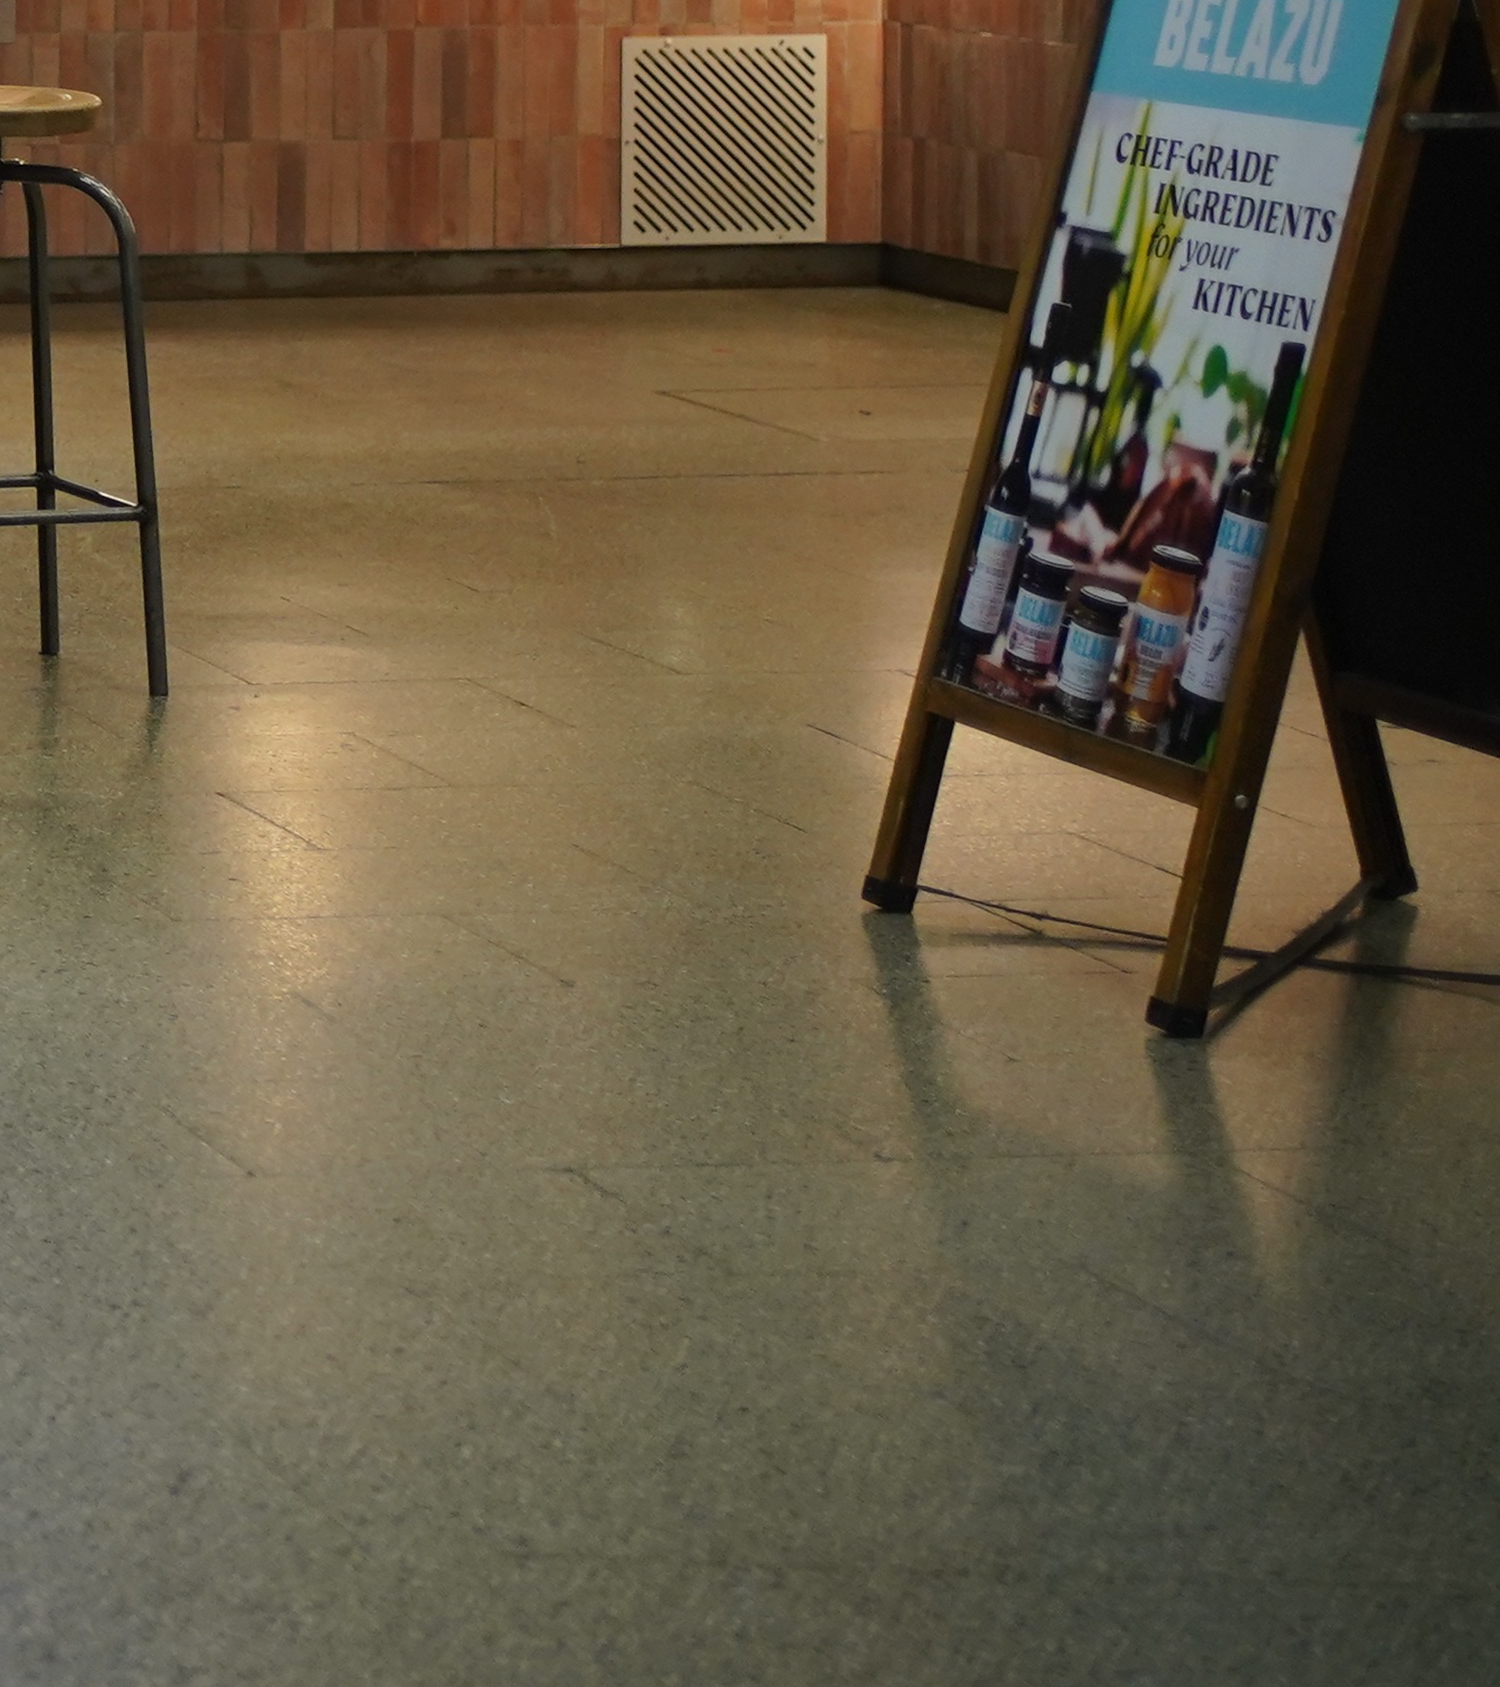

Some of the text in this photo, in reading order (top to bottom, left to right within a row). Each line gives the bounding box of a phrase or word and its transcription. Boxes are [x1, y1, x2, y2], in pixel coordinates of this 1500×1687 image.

[1114, 131, 1281, 188] CHEF-GRADE
[1153, 182, 1338, 244] INGREDIENTS
[1146, 221, 1241, 272] for your
[1191, 277, 1317, 333] KITCHEN
